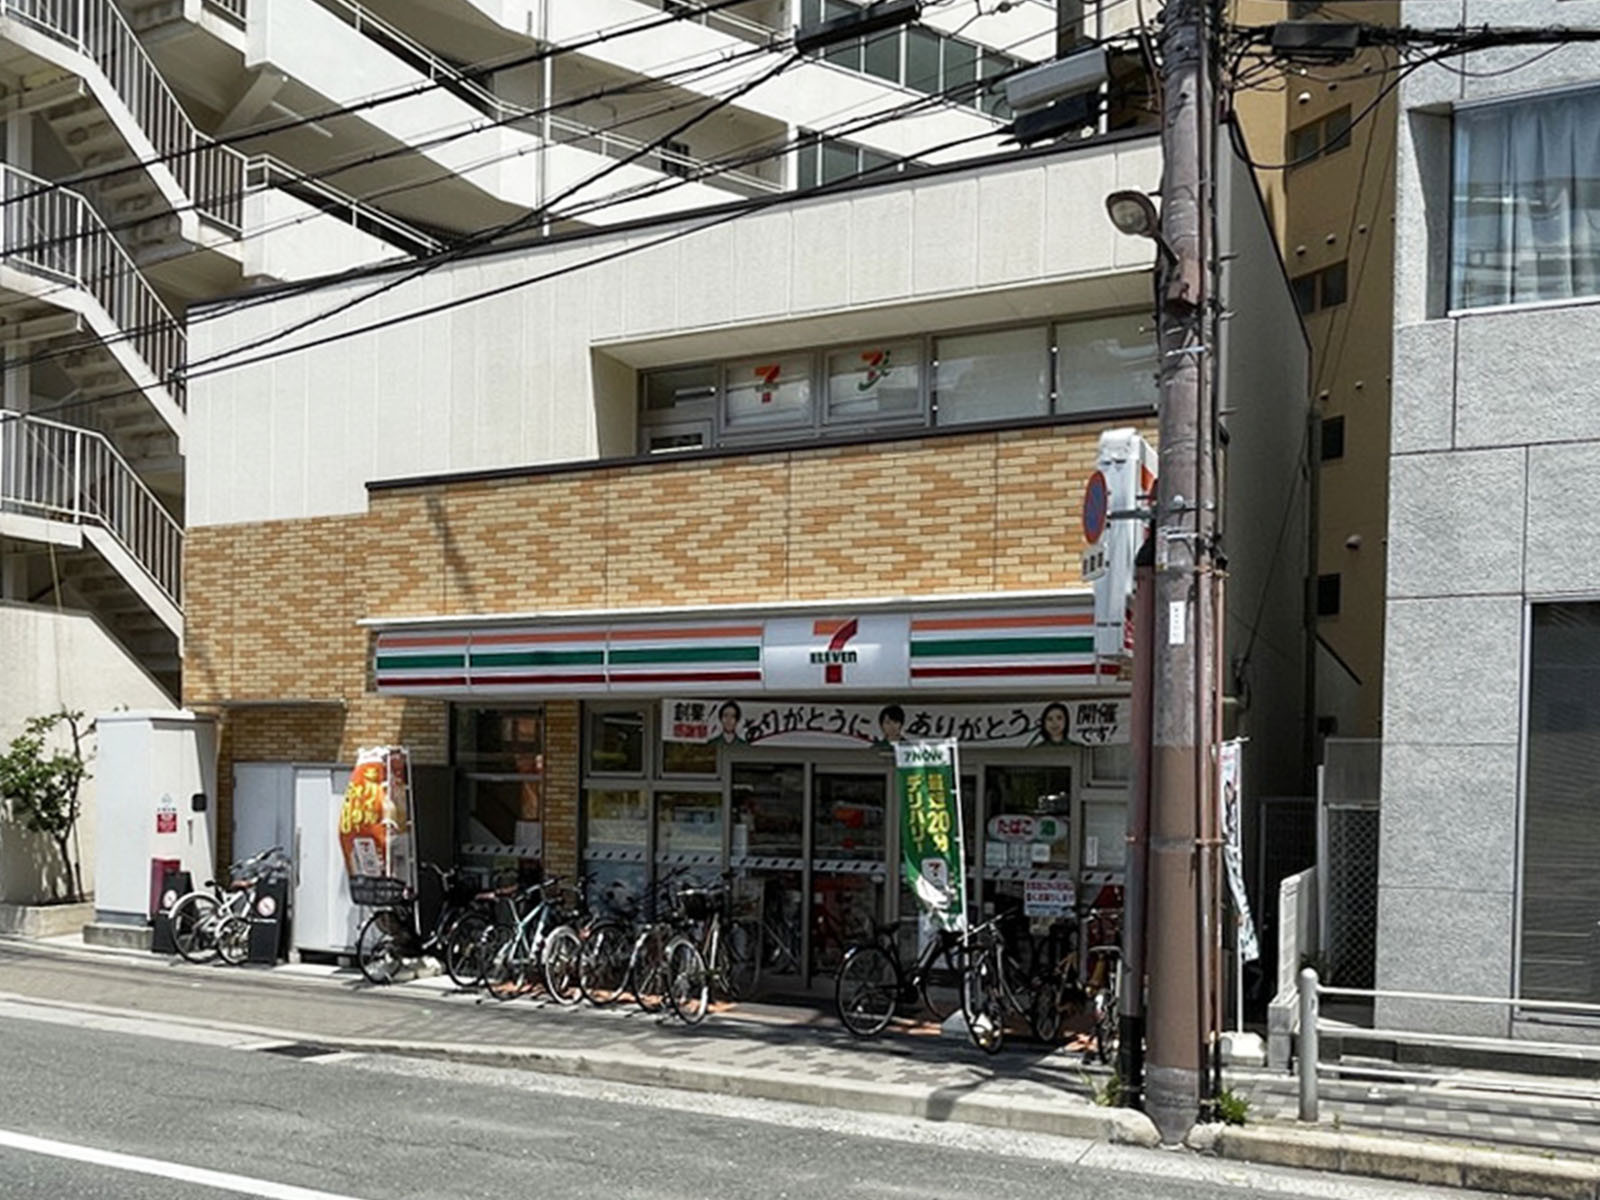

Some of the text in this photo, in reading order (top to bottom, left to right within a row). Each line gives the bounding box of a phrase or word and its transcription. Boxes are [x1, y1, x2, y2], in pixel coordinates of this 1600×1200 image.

[905, 708, 1030, 741] ありがとう
[1076, 703, 1119, 725] 開催
[996, 819, 1033, 836] たばこ
